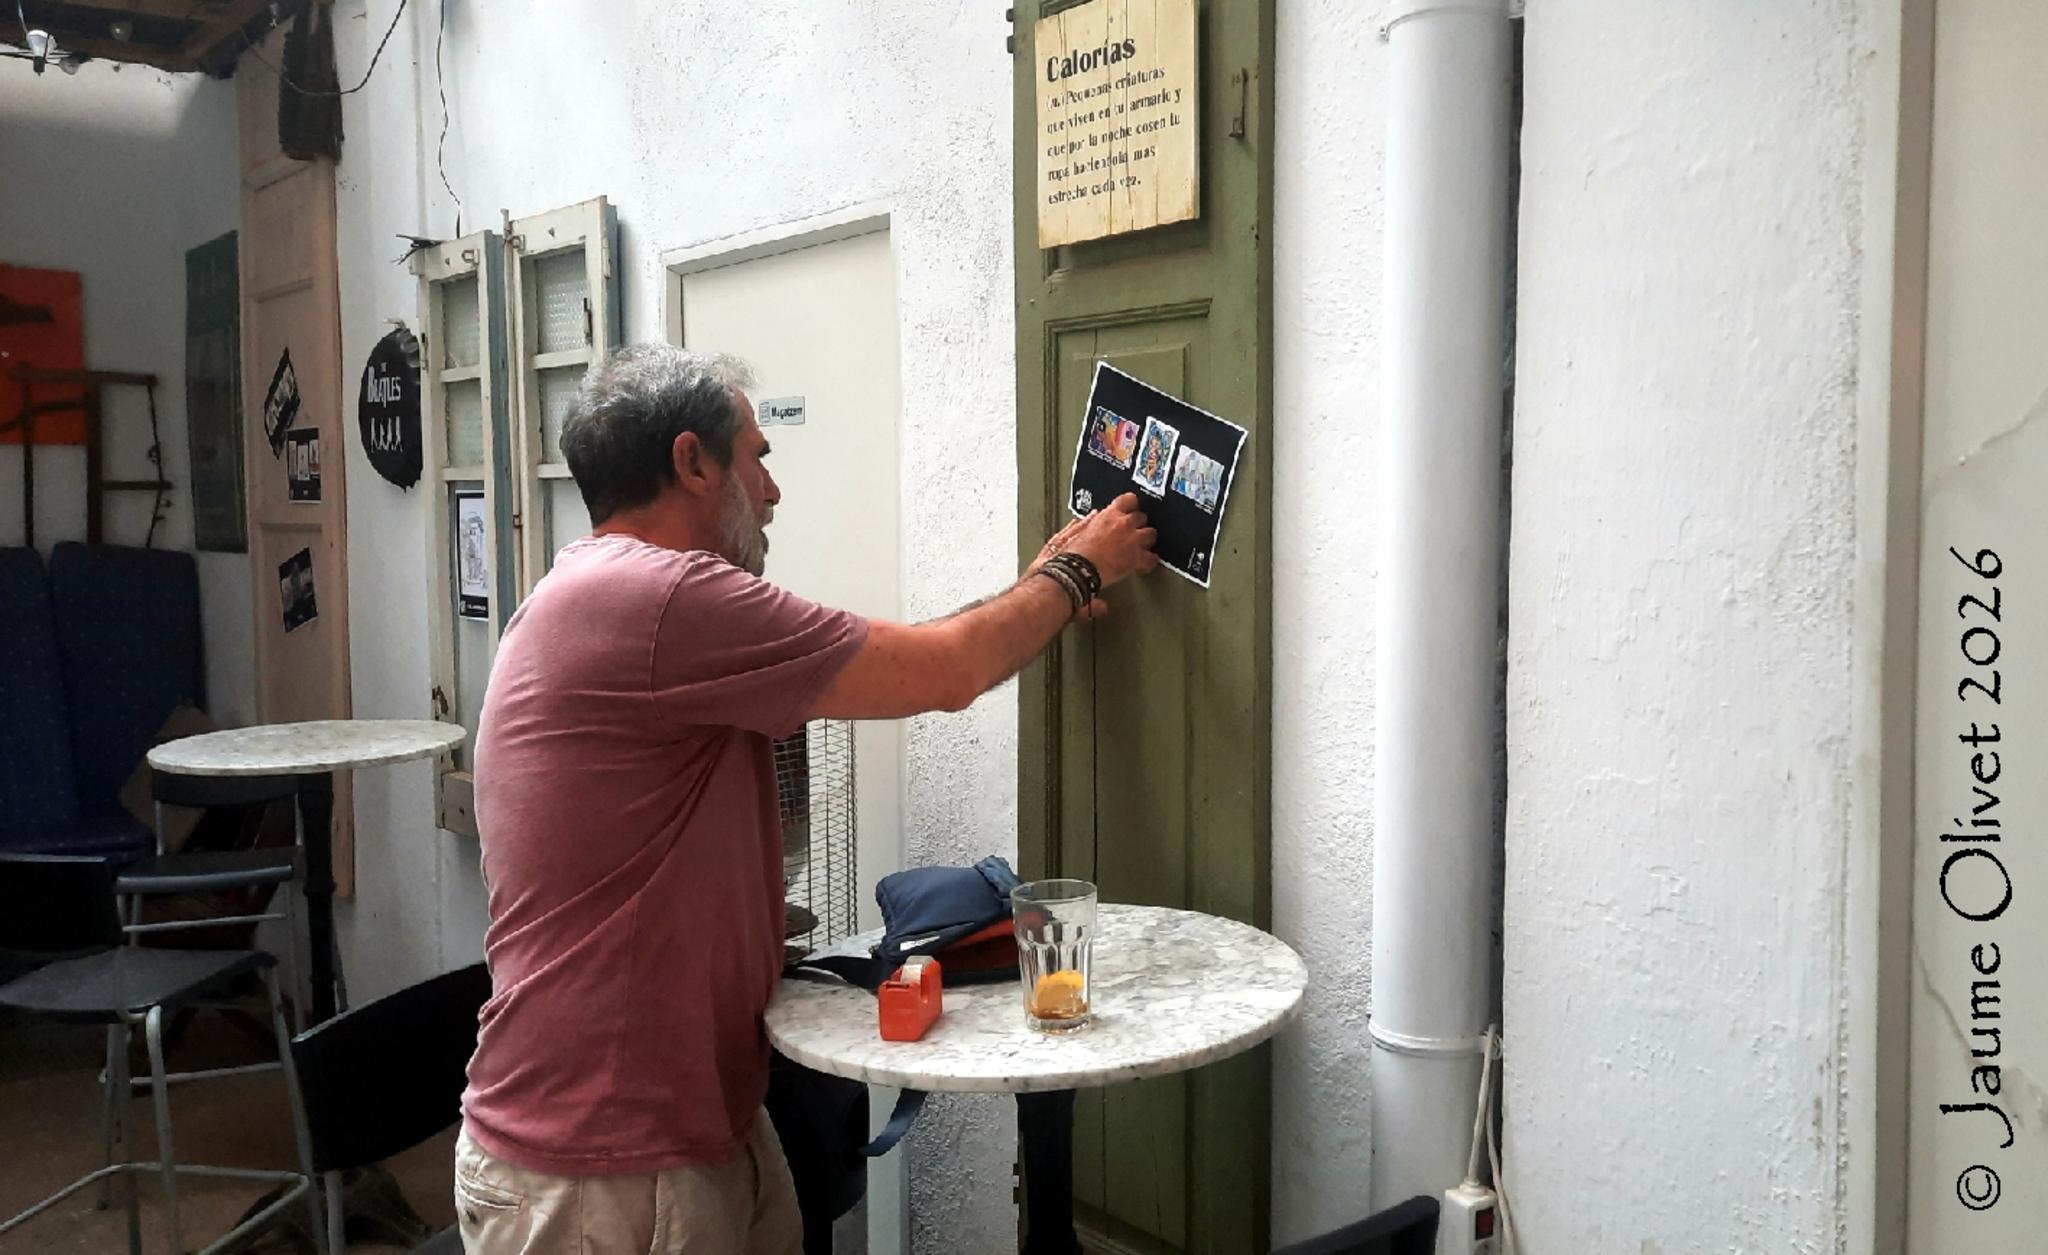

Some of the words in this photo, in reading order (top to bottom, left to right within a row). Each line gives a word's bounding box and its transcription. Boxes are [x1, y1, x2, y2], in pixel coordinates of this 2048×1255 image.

[1047, 37, 1136, 83] Calorías
[1115, 67, 1165, 90] criaturas
[1047, 119, 1065, 134] que
[1068, 111, 1095, 128] viven
[1098, 107, 1110, 119] en
[1130, 88, 1171, 111] armario
[1174, 87, 1182, 103] y
[1047, 143, 1065, 158] que
[1069, 138, 1085, 154] por
[1089, 133, 1098, 147] la
[1102, 125, 1132, 143] noche
[1136, 117, 1166, 135] cosen
[1170, 112, 1181, 126] tu
[1048, 166, 1070, 182] ropa
[1092, 178, 1115, 195] cada
[367, 366, 401, 409] BEATLES
